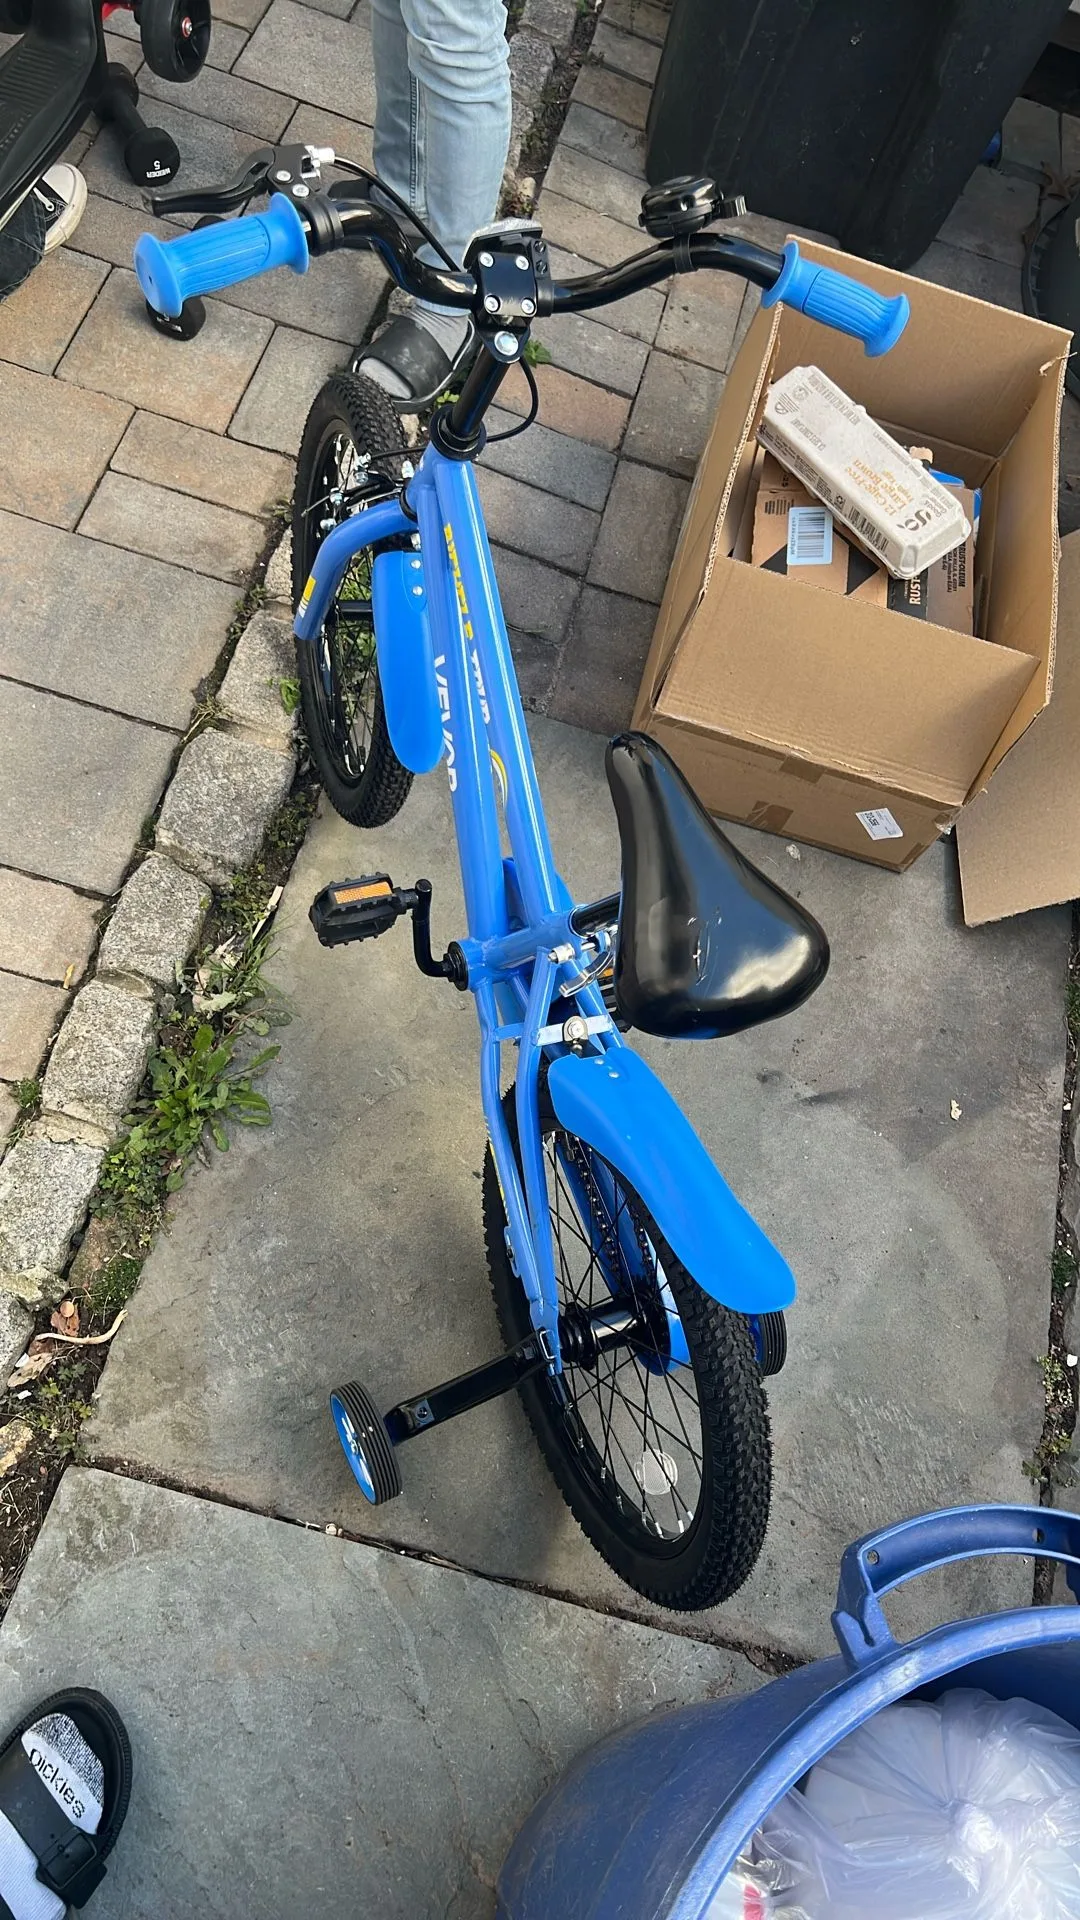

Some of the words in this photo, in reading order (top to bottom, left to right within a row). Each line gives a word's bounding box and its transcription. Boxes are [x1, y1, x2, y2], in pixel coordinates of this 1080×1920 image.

[153, 160, 160, 170] 5
[146, 167, 171, 178] WEIDER
[29, 1748, 86, 1819] Dickies
